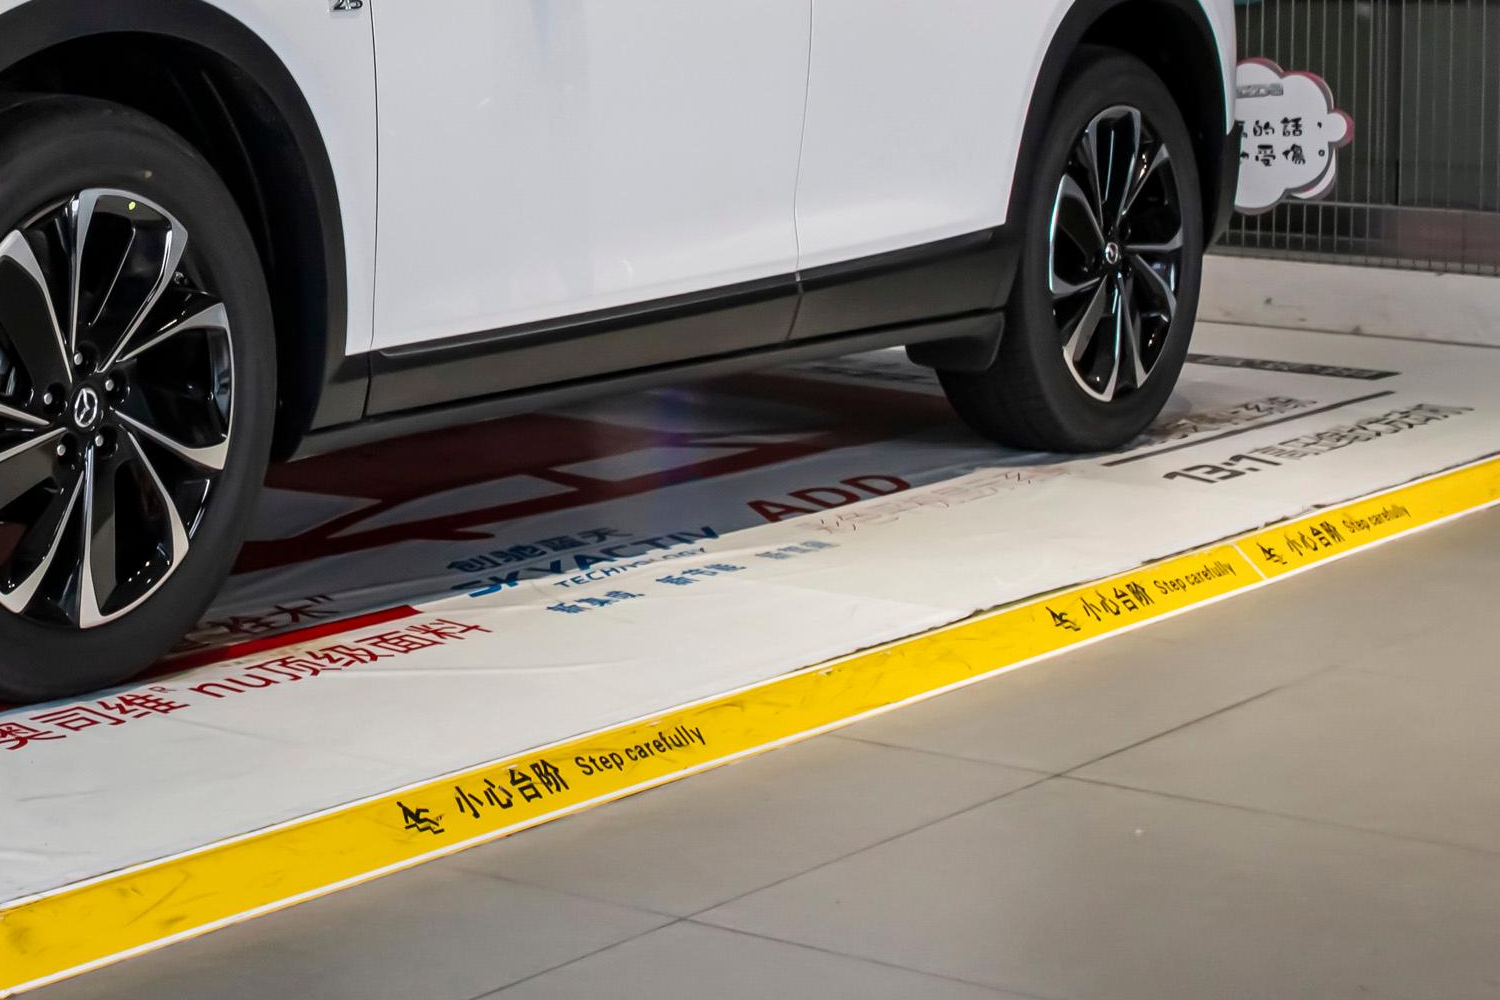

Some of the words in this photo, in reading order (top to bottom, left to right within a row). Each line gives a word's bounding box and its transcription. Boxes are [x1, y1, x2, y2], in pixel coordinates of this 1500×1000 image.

[446, 527, 634, 573] 创驰蓝天
[1284, 520, 1345, 556] 小心台阶
[1342, 514, 1370, 533] Step
[1368, 504, 1411, 525] carefully
[450, 525, 721, 599] SKYACTIV
[1080, 581, 1155, 621] 小心台阶
[1153, 573, 1187, 595] Step
[1185, 561, 1237, 584] carefully
[455, 758, 569, 818] 小心台阶
[575, 751, 626, 776] Step
[625, 724, 706, 762] carefully
